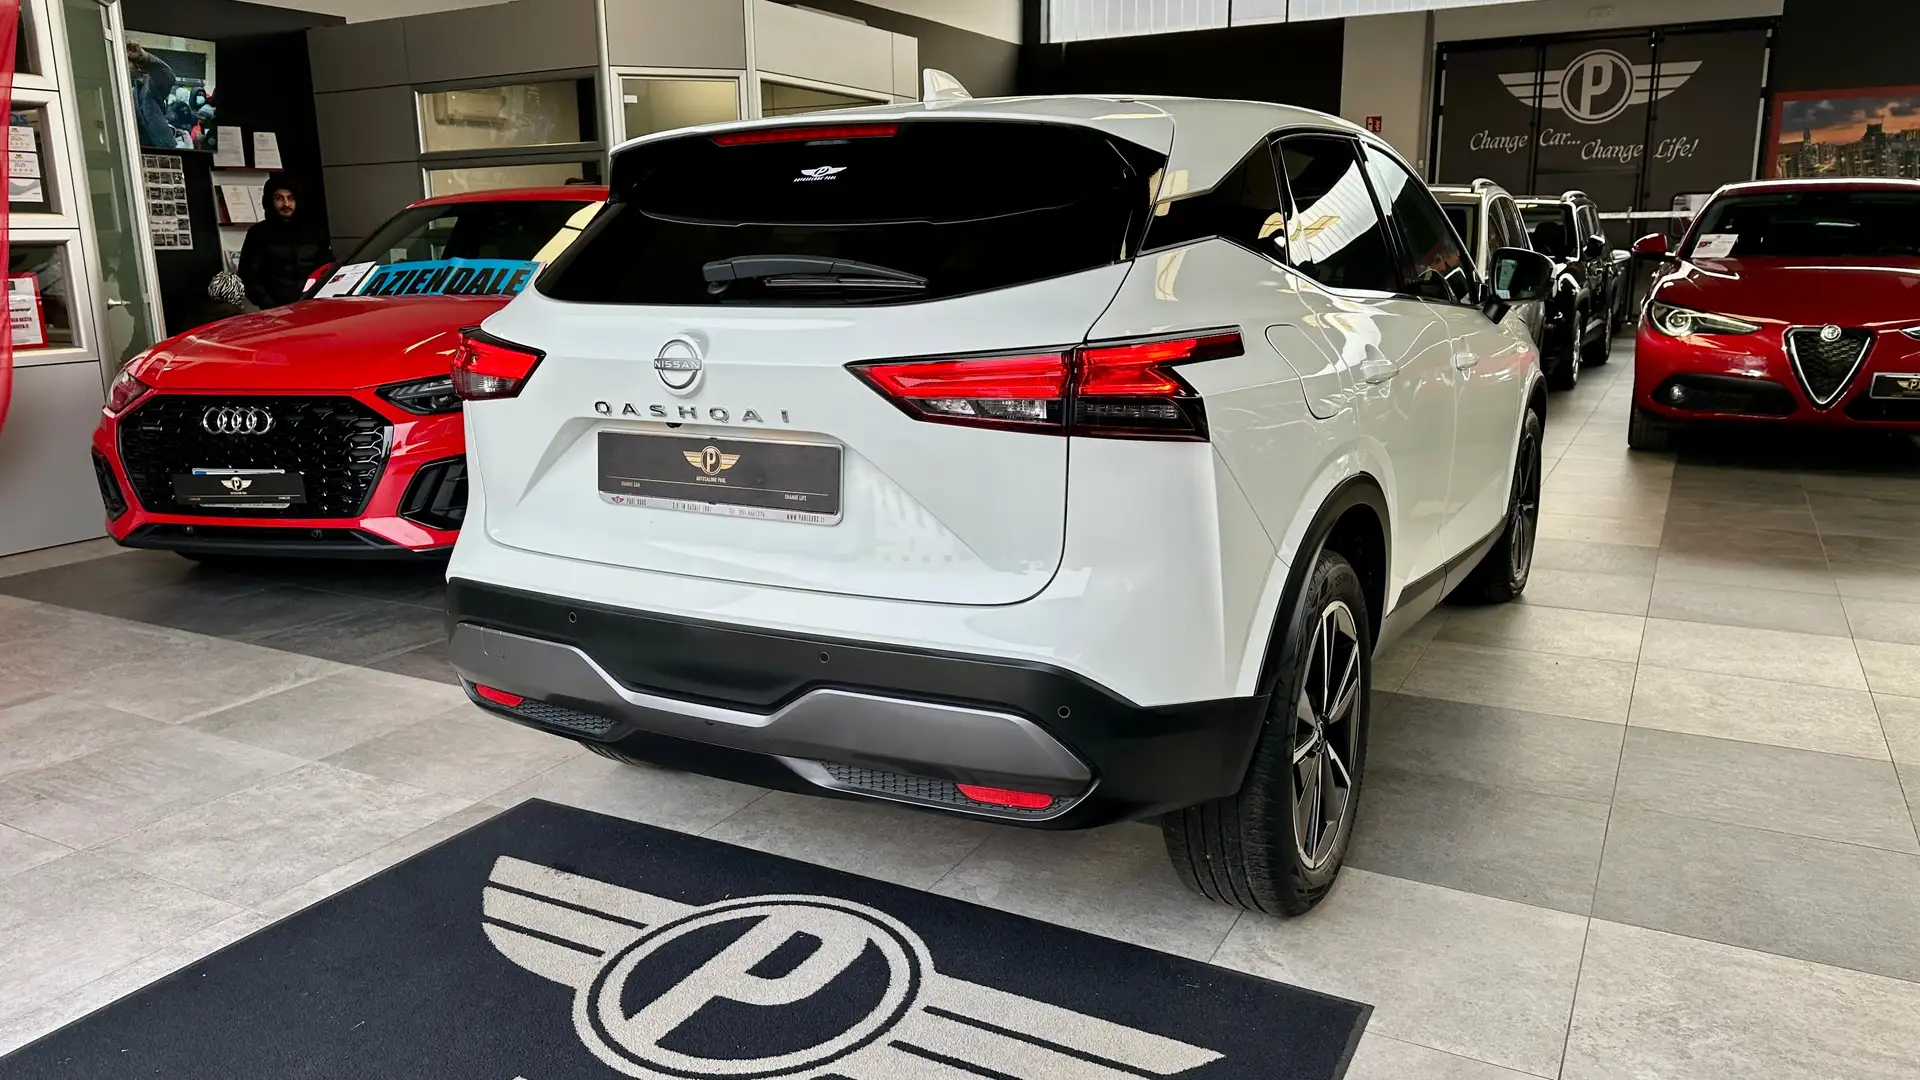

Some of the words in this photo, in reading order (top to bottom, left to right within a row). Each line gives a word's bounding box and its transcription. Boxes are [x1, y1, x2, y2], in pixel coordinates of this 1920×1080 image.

[1470, 130, 1528, 154] Change
[1539, 128, 1581, 147] Car...
[1581, 139, 1644, 163] Change
[1653, 136, 1700, 163] Life!
[366, 267, 532, 296] AZIENDALE
[654, 359, 702, 370] NISSAN
[594, 400, 790, 423] QASHQAI
